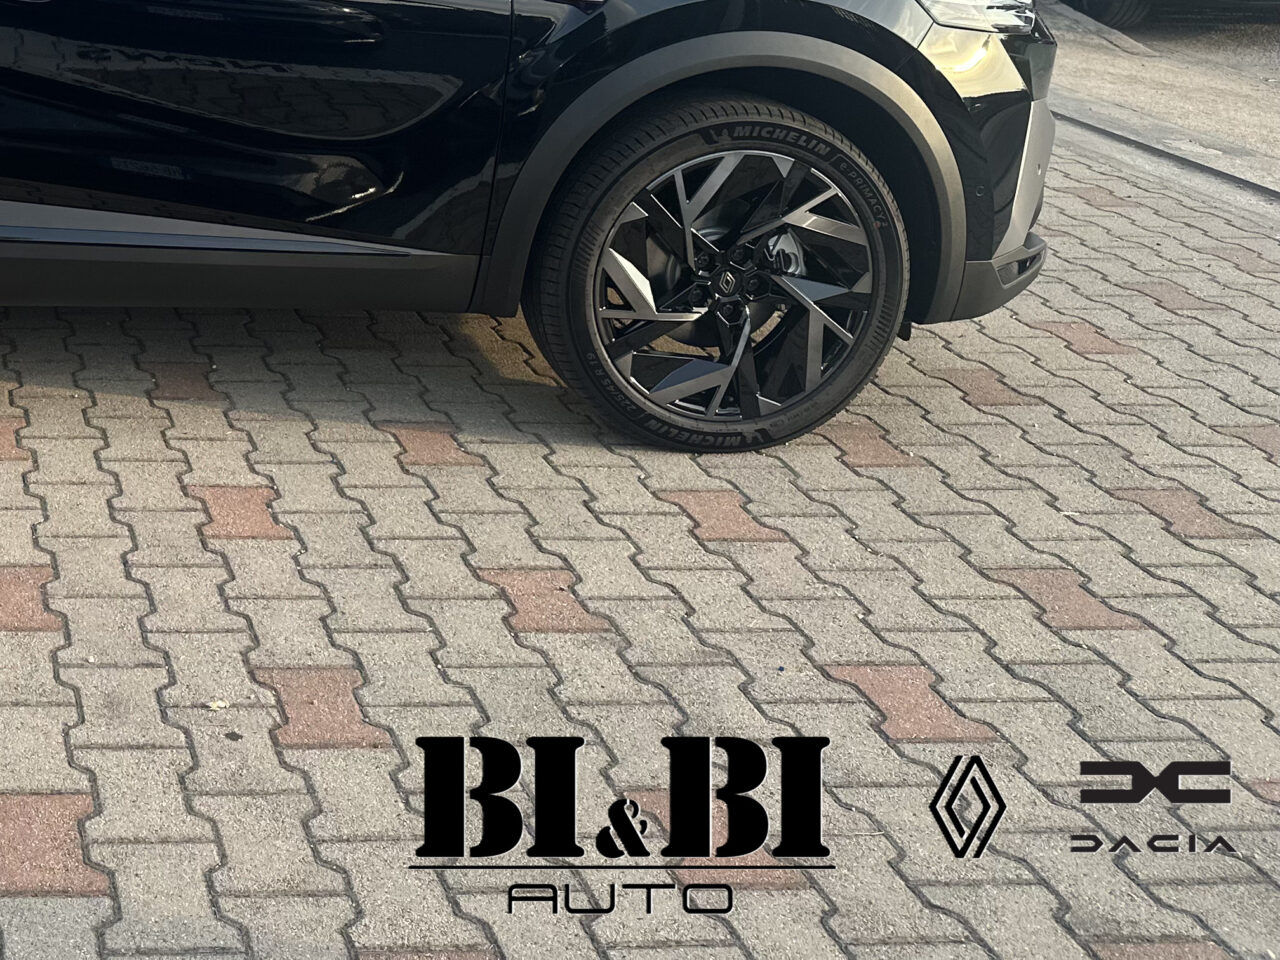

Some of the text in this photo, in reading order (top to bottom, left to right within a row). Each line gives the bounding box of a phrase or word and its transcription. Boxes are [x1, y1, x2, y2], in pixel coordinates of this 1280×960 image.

[733, 125, 833, 158] MICHELIN
[586, 352, 600, 366] 19
[644, 417, 741, 447] MICHELIN
